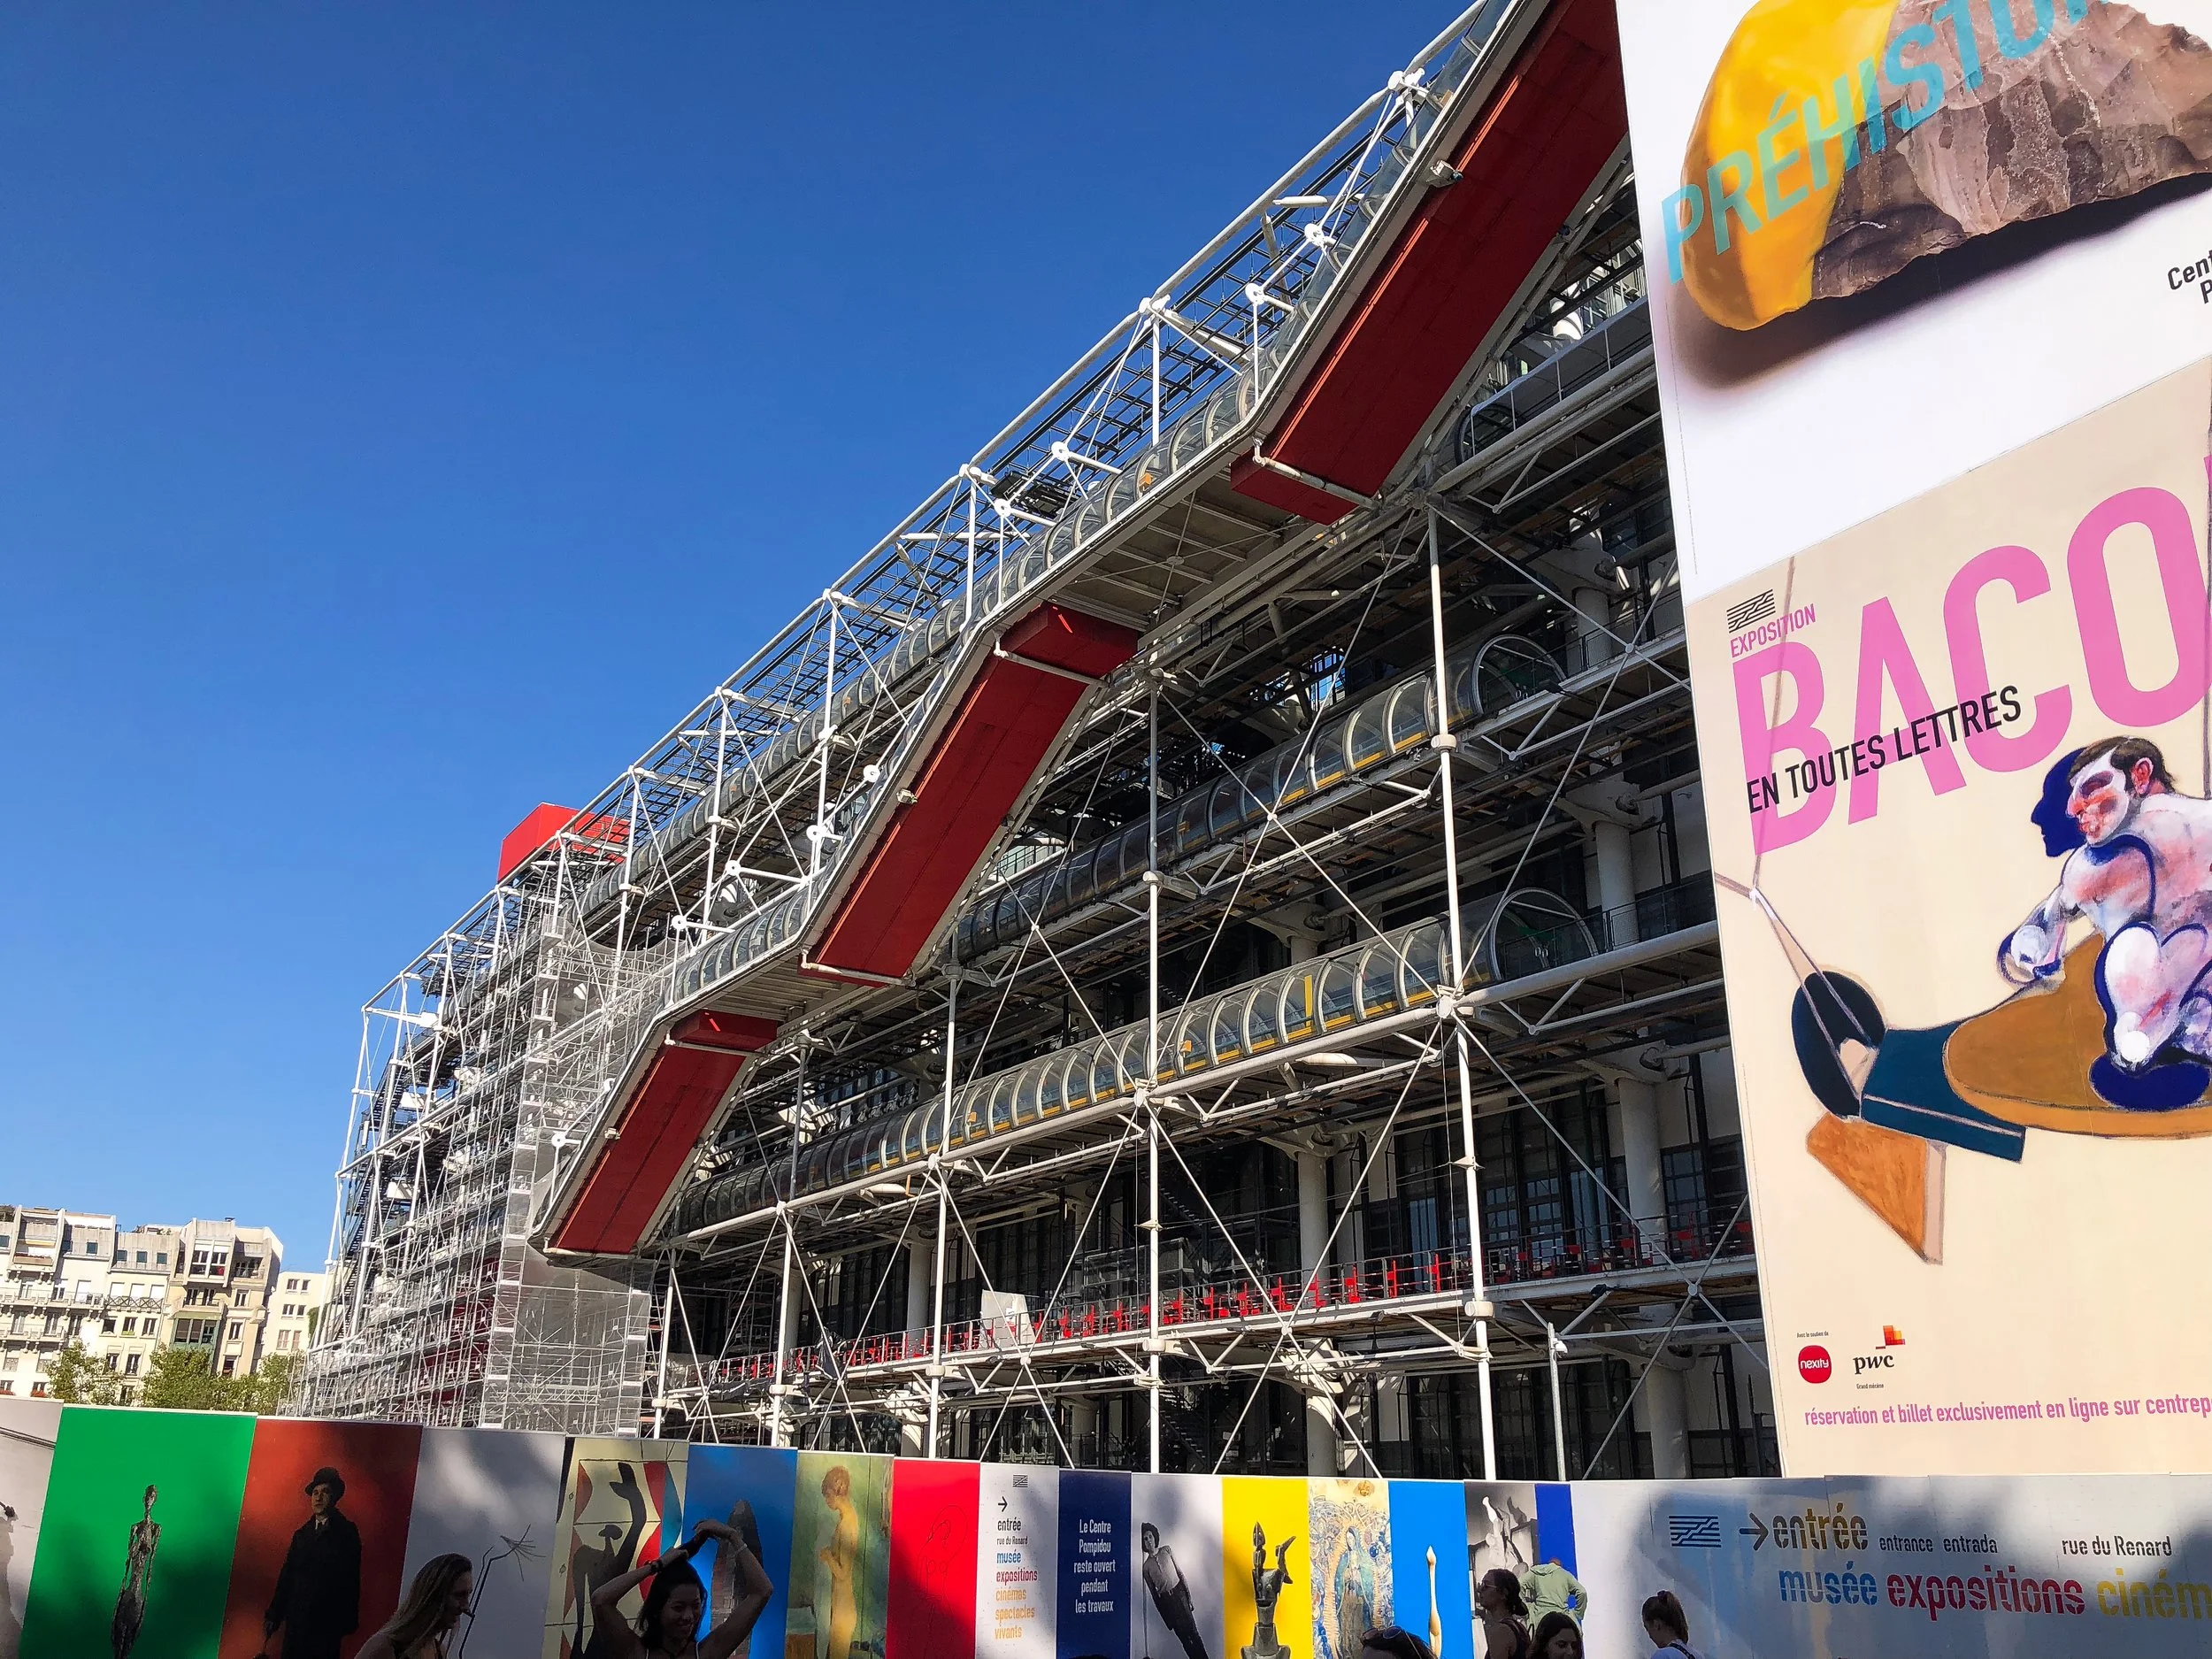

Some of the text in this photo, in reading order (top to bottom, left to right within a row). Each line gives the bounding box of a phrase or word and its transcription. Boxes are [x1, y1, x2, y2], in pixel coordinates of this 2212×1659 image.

[1661, 0, 2108, 284] PRÉHISTO
[1731, 603, 1816, 658] EXPOSITION
[1732, 454, 2212, 856] BACO
[1747, 685, 2022, 813] EN TOUTES LETTRES
[1800, 1358, 1830, 1369] nexity
[1853, 1355, 1894, 1375] pwc
[1805, 1394, 2212, 1425] réservation et billet exclusivement en ligne sur centrep
[997, 1517, 1021, 1531] entrée
[1079, 1518, 1111, 1533] Le Centre
[1772, 1502, 2172, 1556] entrée entrance entrada rue du Renard
[1005, 1536, 1011, 1545] du
[1012, 1536, 1028, 1545] Renard
[1079, 1539, 1111, 1556] Pompidou
[996, 1549, 1021, 1563] musée
[1074, 1559, 1116, 1573] reste ouvert
[996, 1567, 1037, 1586] expositions
[1081, 1578, 1108, 1596] pendant
[1778, 1561, 1878, 1605] musée
[1887, 1564, 2085, 1621] expositions
[995, 1605, 1034, 1622] spectacles
[1075, 1600, 1114, 1613] les travaux
[995, 1622, 1023, 1639] vivants
